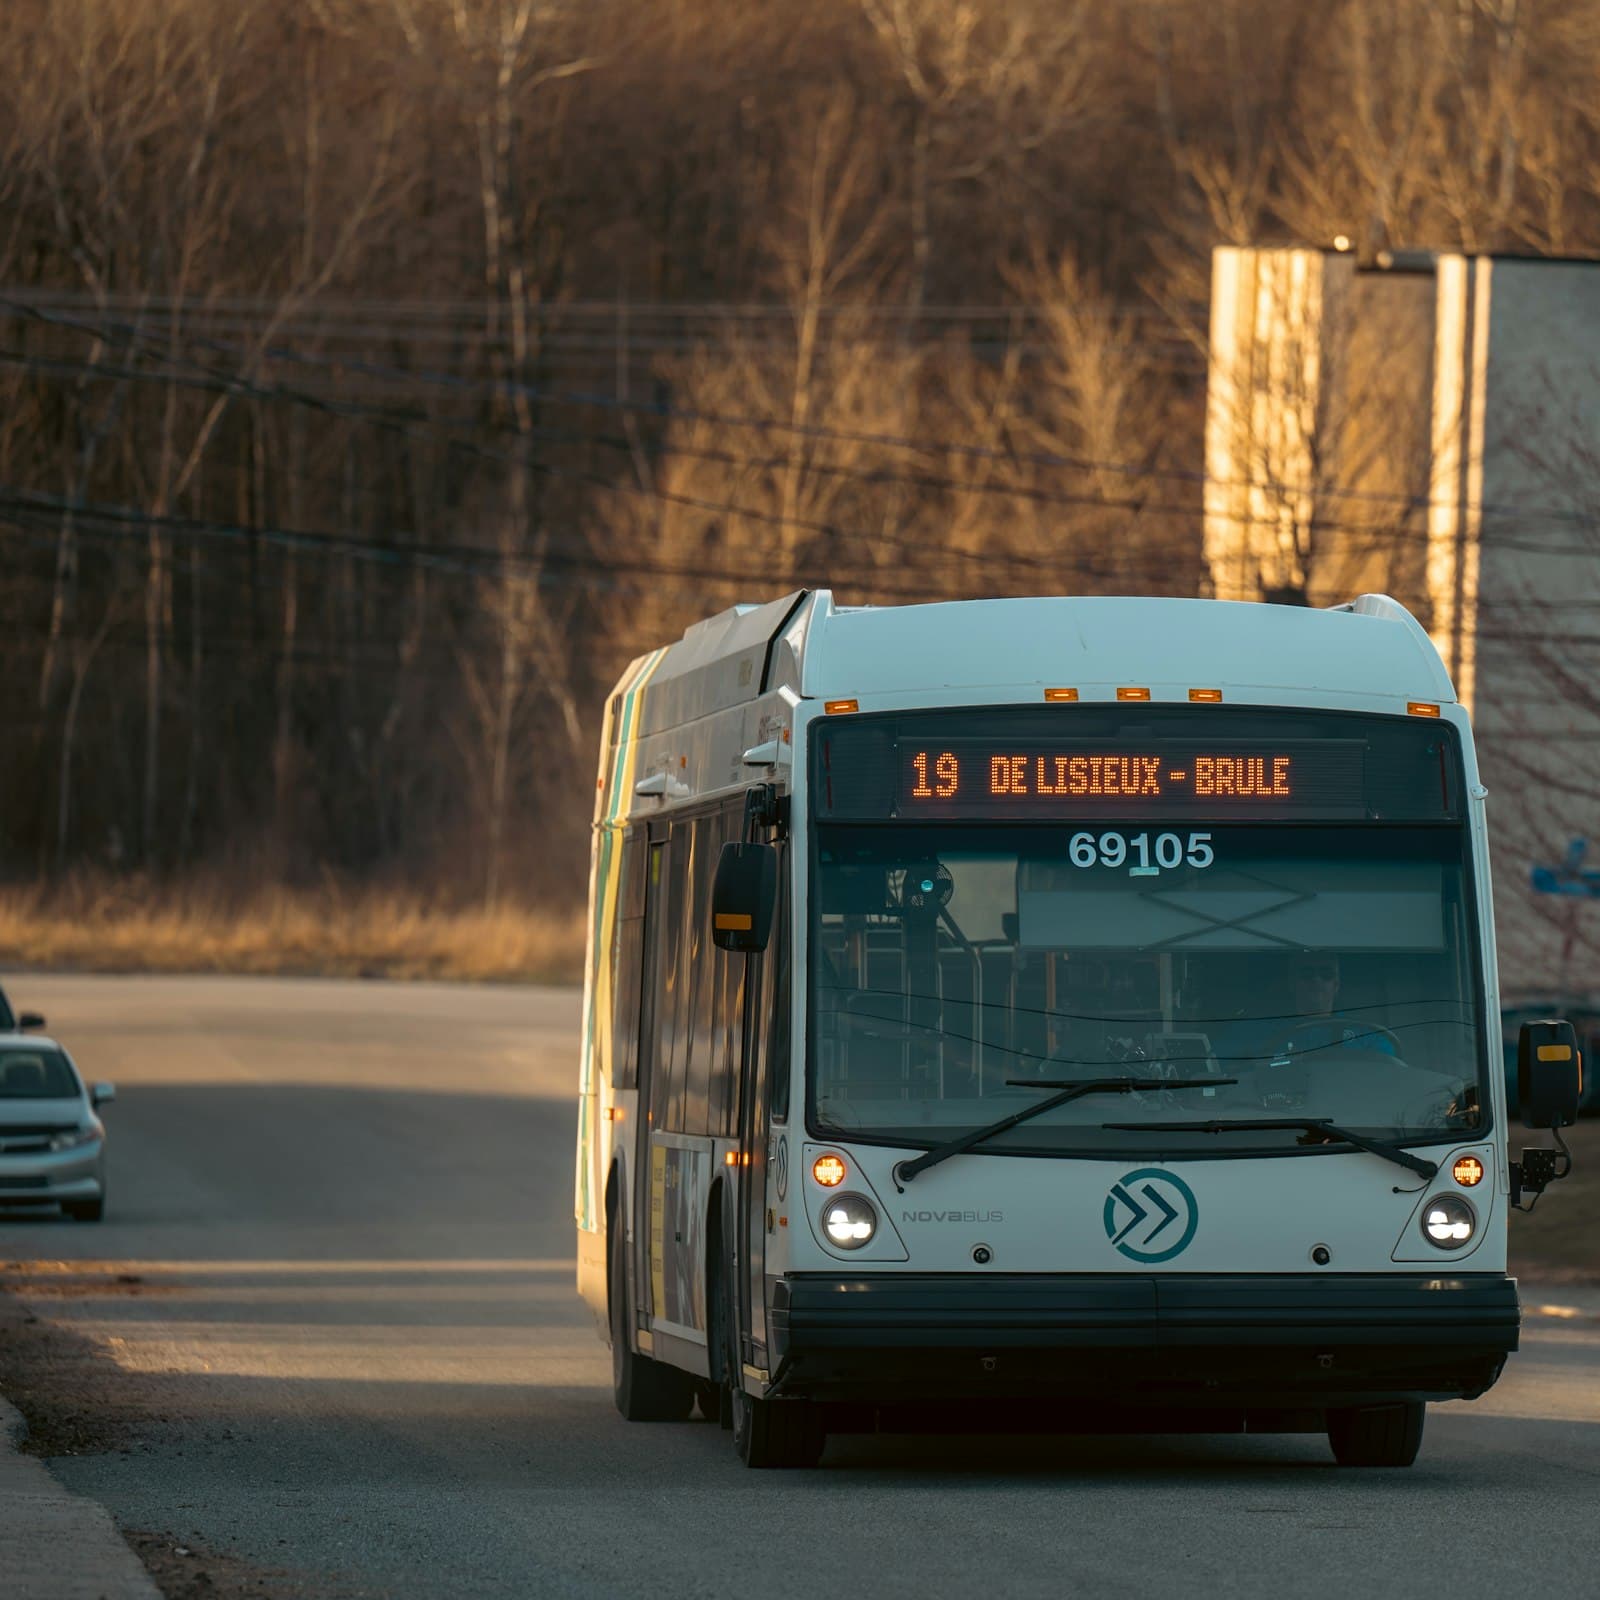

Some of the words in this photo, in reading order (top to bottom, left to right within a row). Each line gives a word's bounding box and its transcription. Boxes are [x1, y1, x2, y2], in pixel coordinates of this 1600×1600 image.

[912, 752, 958, 797] 19
[991, 756, 1028, 794] DE
[1037, 757, 1160, 794] LISIEUX
[1195, 757, 1289, 795] BRULE
[1069, 833, 1214, 868] 69105
